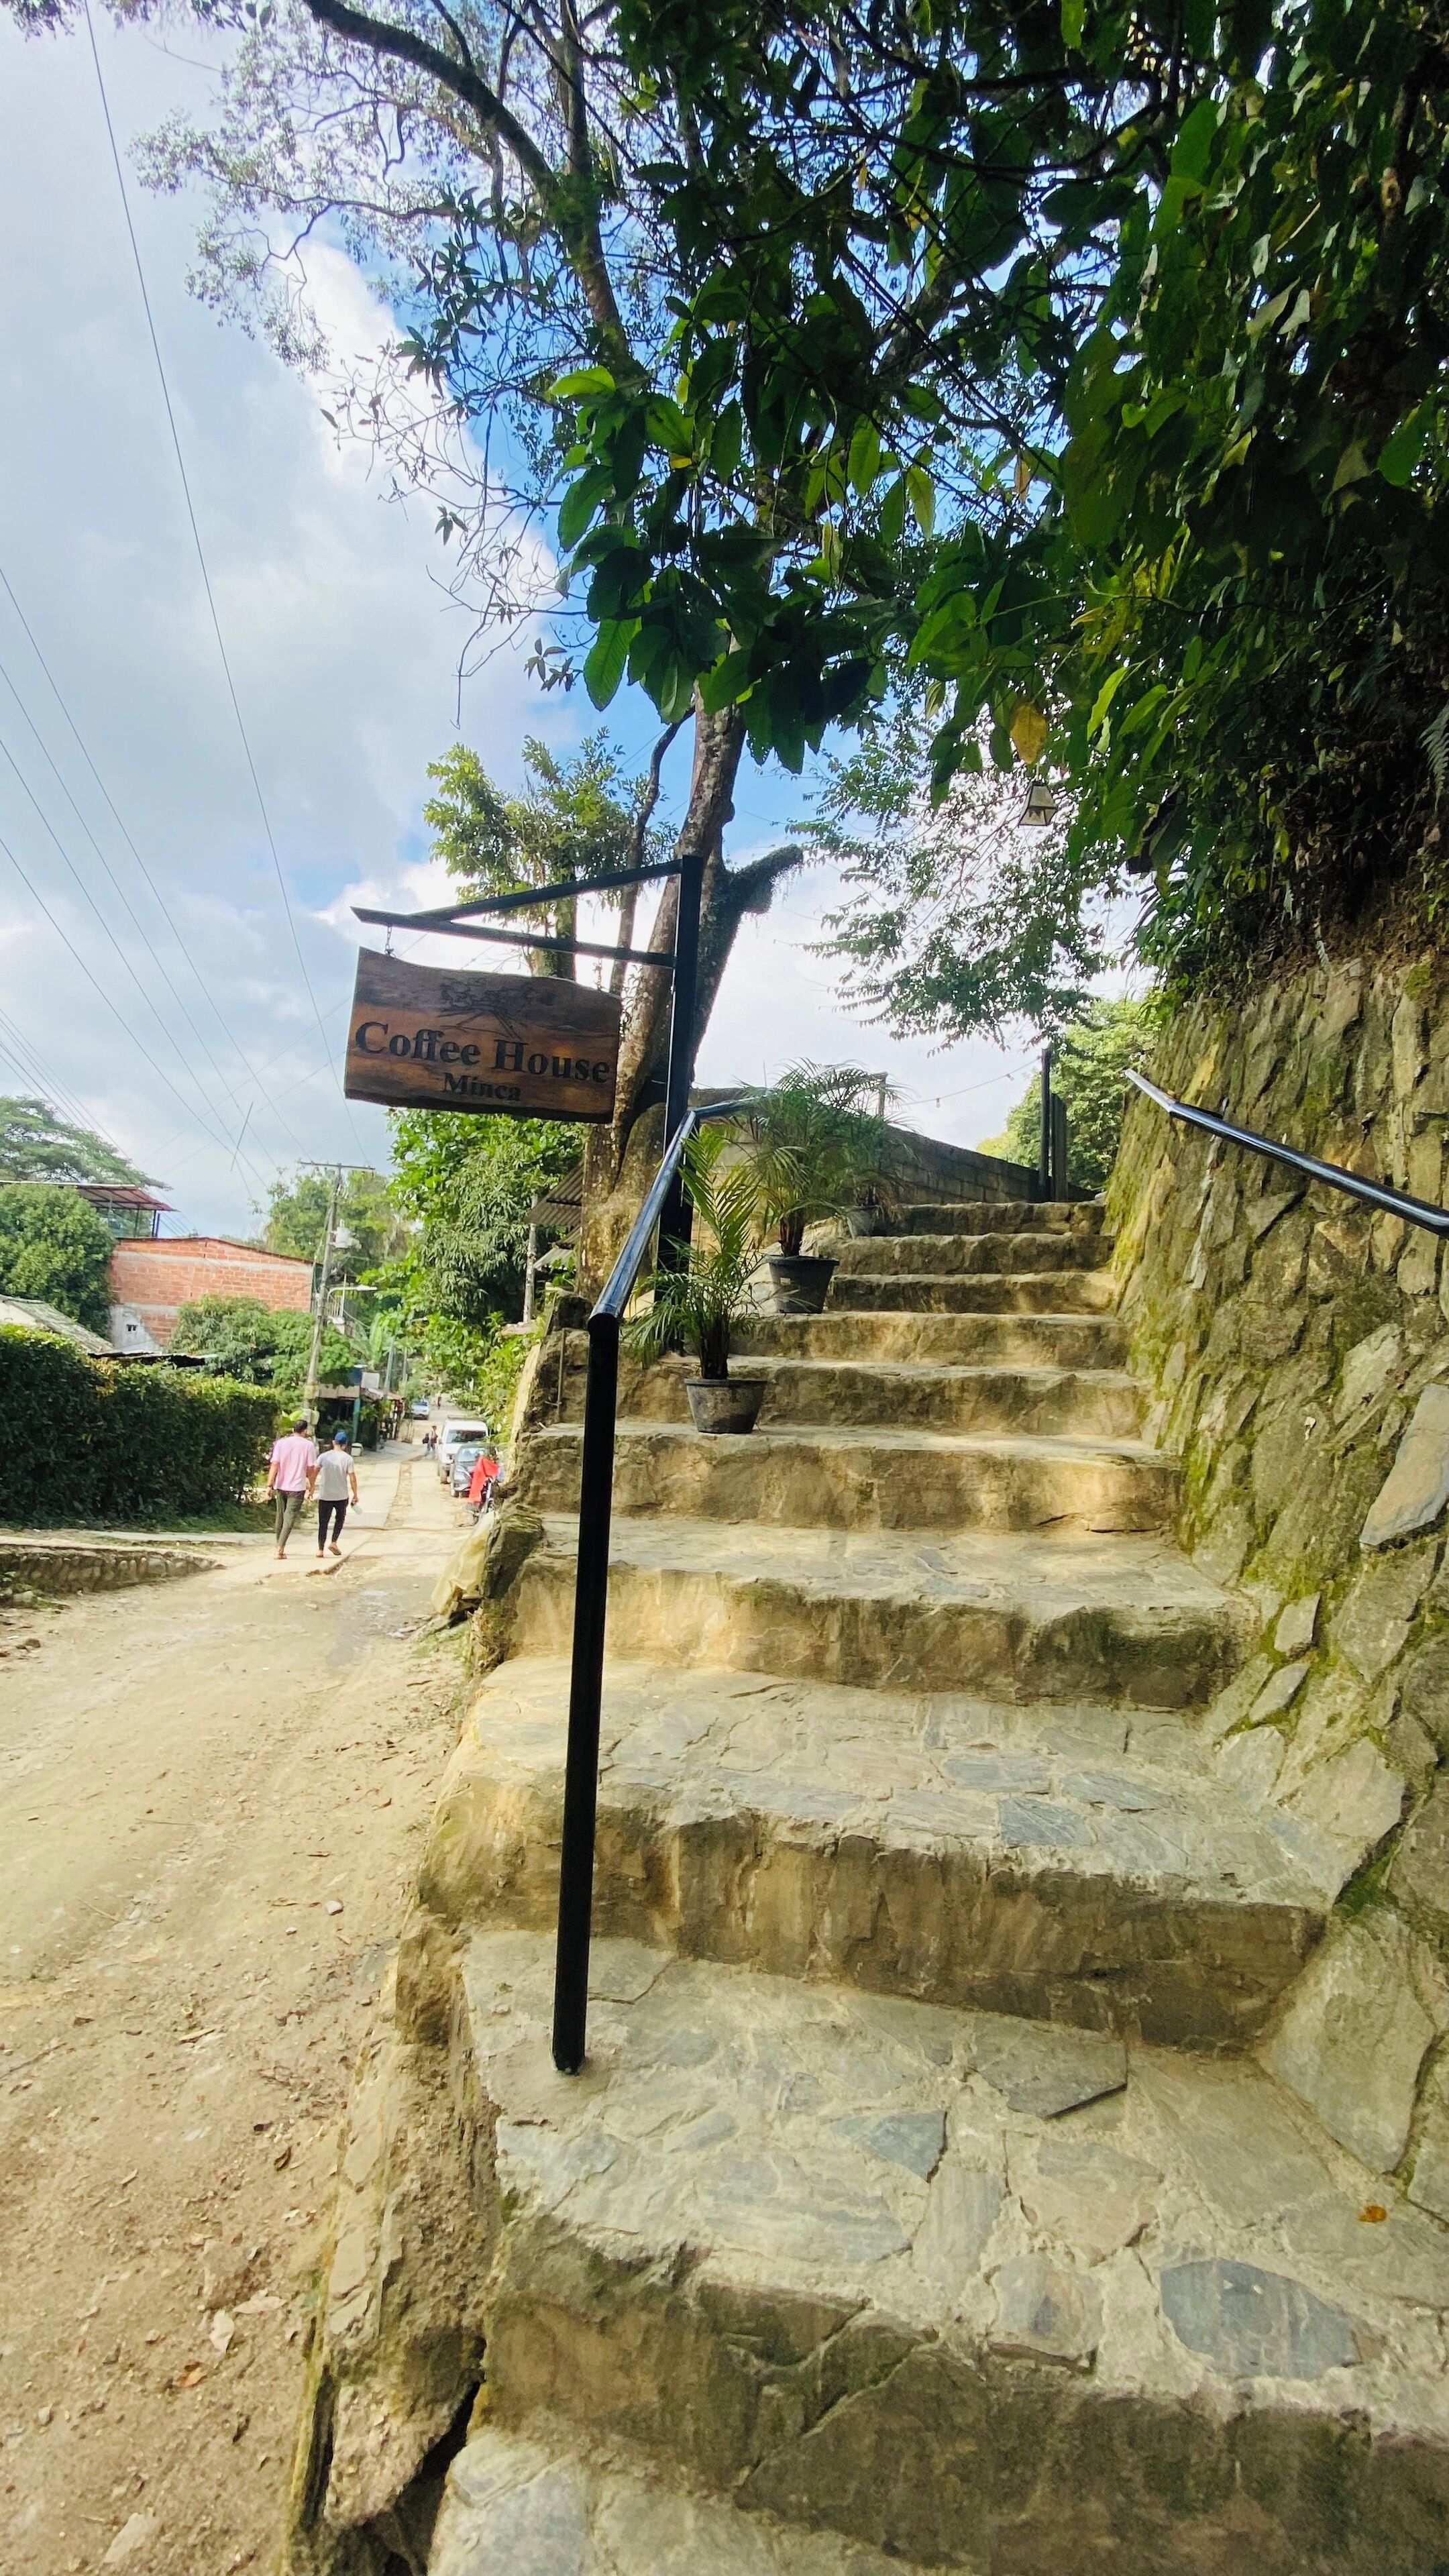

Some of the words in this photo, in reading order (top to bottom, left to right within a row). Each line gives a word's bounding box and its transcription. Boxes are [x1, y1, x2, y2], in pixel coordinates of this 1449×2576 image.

[355, 1021, 480, 1065] Coffee
[494, 1039, 610, 1083] House
[443, 1072, 521, 1102] Minca
